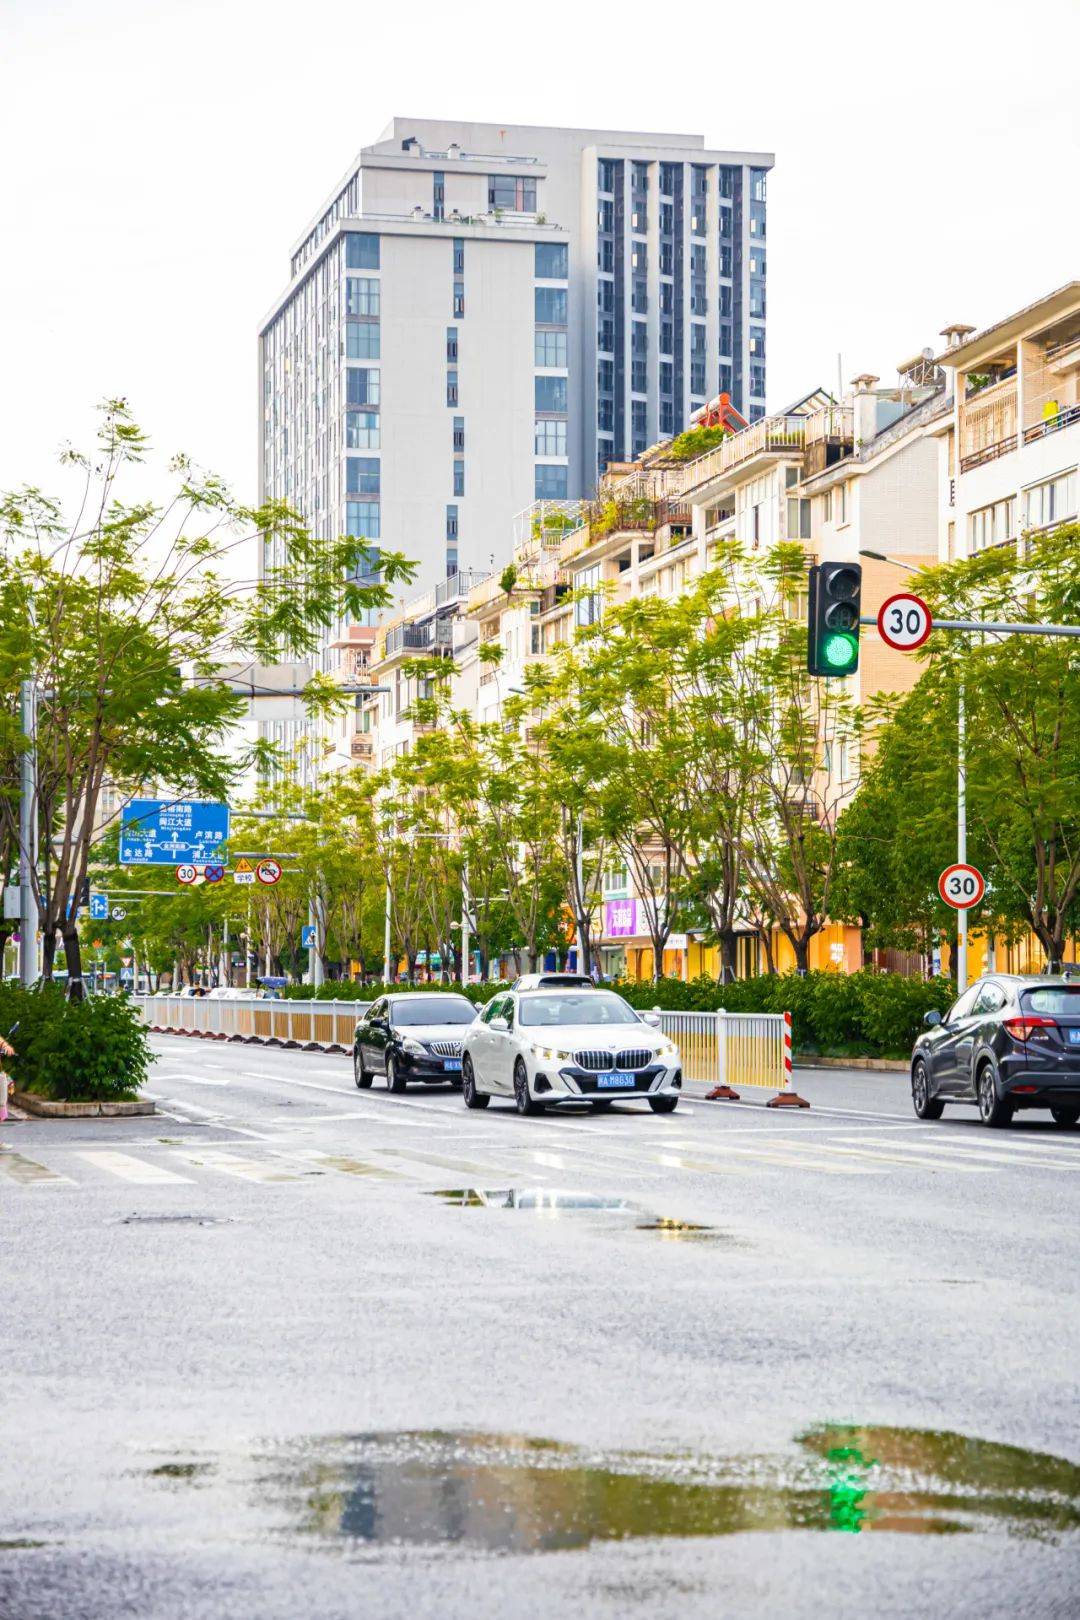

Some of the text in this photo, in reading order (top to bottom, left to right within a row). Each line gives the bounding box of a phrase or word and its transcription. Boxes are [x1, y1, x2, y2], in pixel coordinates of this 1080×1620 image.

[890, 609, 920, 635] 30
[181, 868, 193, 879] 30
[949, 877, 975, 895] 30
